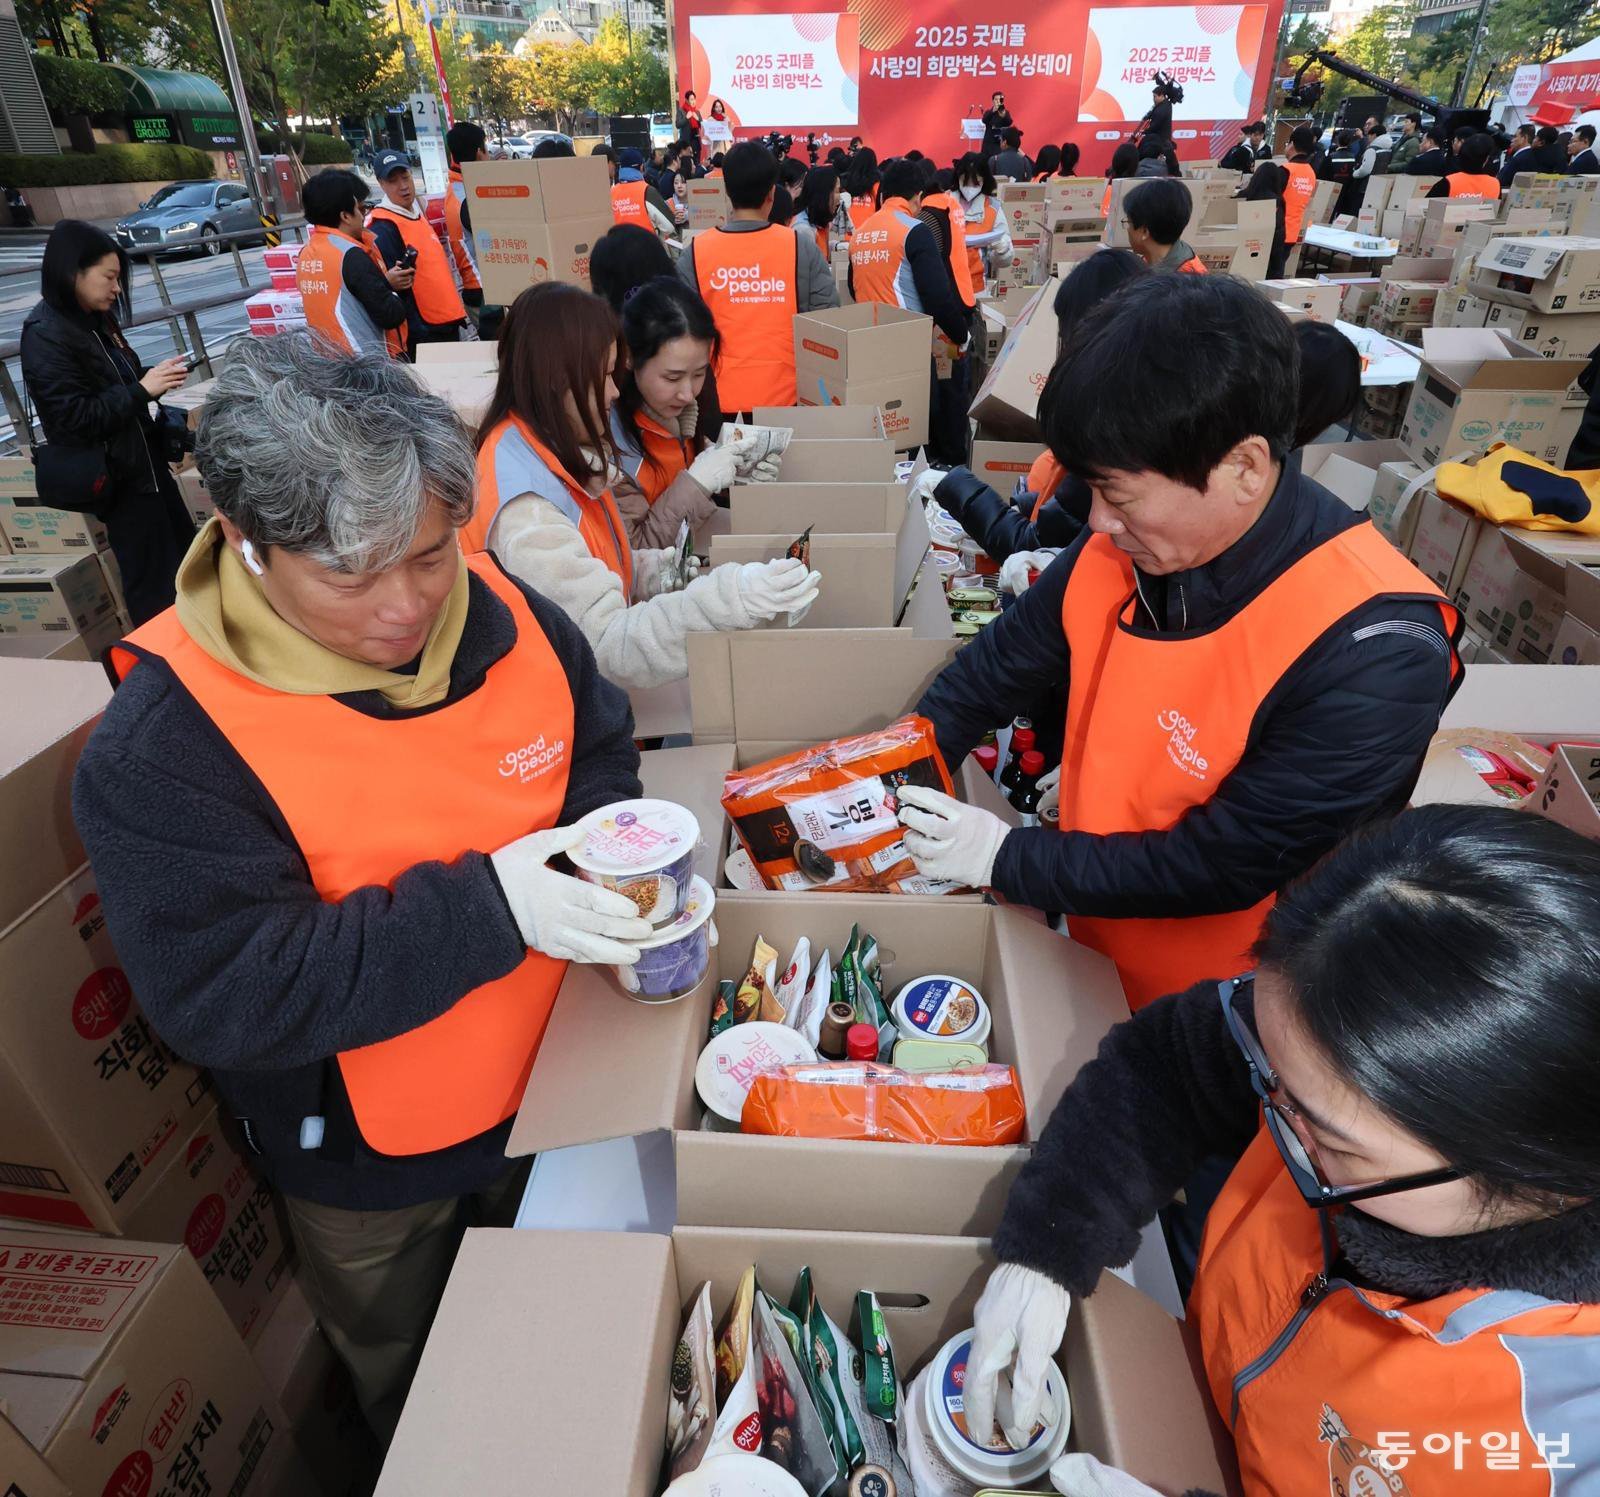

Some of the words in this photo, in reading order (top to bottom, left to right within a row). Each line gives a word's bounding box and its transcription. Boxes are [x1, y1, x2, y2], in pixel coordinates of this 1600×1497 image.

[915, 26, 967, 47] 2025
[973, 24, 1026, 47] 굿피플
[736, 55, 773, 70] 2025
[776, 53, 815, 70] 굿피플
[870, 56, 922, 79] 사랑의
[927, 54, 997, 78] 희망박스
[1002, 53, 1073, 76] 박싱데이
[1128, 48, 1168, 62] 2025
[1171, 46, 1212, 62] 굿피플
[731, 74, 769, 90] 사랑의
[772, 74, 823, 90] 희망박스
[1547, 75, 1577, 94] 사회자
[1577, 72, 1600, 92] 대기
[416, 101, 425, 114] 2
[135, 128, 171, 138] GROUND
[612, 198, 630, 211] good
[618, 204, 641, 213] people
[856, 230, 888, 245] 푸드뱅크
[710, 263, 760, 290] good
[729, 277, 786, 295] people
[1158, 710, 1197, 742] good
[498, 733, 546, 777] good
[519, 740, 564, 777] people
[1169, 729, 1208, 770] people
[802, 810, 827, 842] 재래김
[826, 798, 876, 831] 명가
[79, 909, 104, 941] 뜯는
[79, 977, 126, 1033] 햇반
[231, 1222, 269, 1289] 덮밥
[147, 1384, 189, 1451] 컵반
[737, 1413, 761, 1448] 햇반
